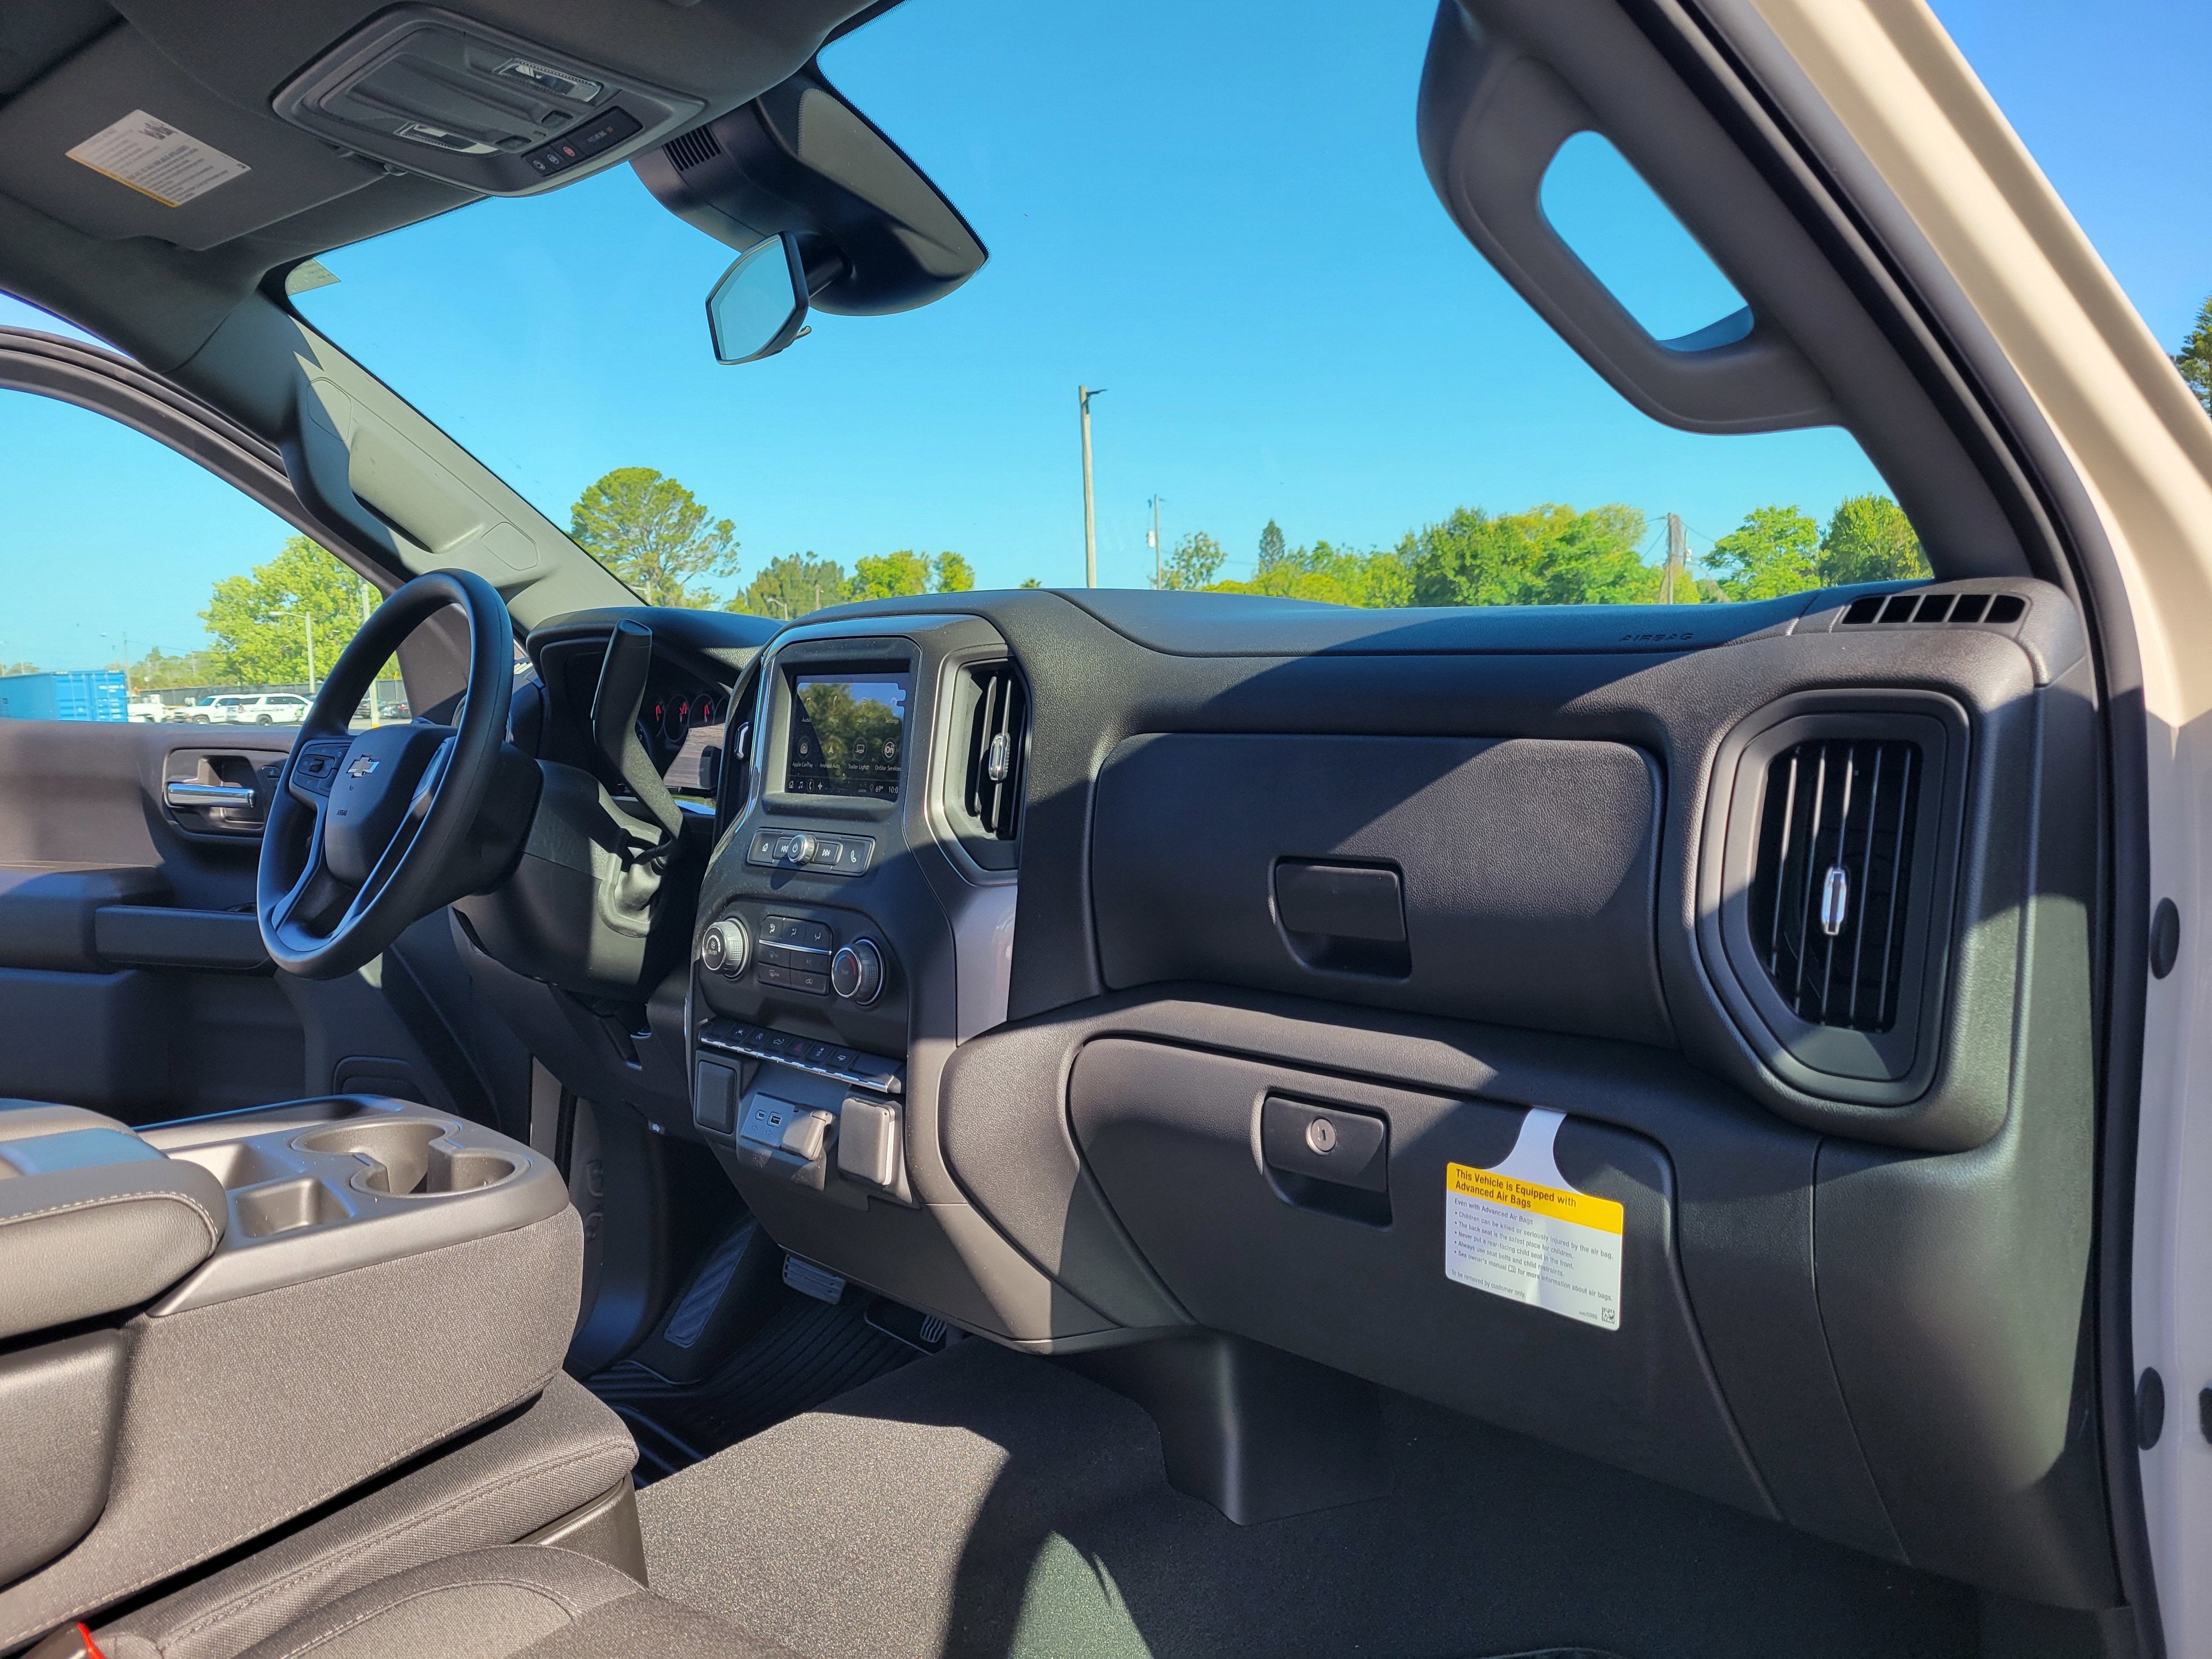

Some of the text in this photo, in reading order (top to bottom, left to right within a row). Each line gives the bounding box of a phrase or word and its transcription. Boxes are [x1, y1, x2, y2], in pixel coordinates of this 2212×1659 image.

[1620, 633, 1693, 641] AIRBAG
[1455, 1180, 1531, 1208] Advanced Air Bags
[1456, 1169, 1576, 1207] This Vehicle is Equipped with
[1455, 1198, 1467, 1207] Even
[1481, 1205, 1508, 1218] Advanced
[1519, 1215, 1533, 1225] Bags
[1459, 1211, 1480, 1222] Children
[1500, 1223, 1515, 1232] killed
[1523, 1229, 1549, 1242] seriously
[1550, 1236, 1570, 1247] injured
[1571, 1242, 1578, 1250] by
[1580, 1244, 1589, 1252] the
[1600, 1250, 1613, 1260] bag.
[1459, 1231, 1472, 1239] Never
[1487, 1241, 1515, 1254] rear-facing
[1516, 1248, 1530, 1256] child
[1531, 1252, 1543, 1260] seat
[1560, 1260, 1574, 1269] front.
[1469, 1224, 1480, 1233] back
[1509, 1235, 1525, 1245] safest
[1526, 1240, 1541, 1249] place
[1550, 1247, 1574, 1259] children.
[1458, 1240, 1475, 1251] Always
[1498, 1252, 1511, 1261] belts
[1523, 1260, 1537, 1268] child
[1538, 1264, 1564, 1277] restraints.
[1458, 1250, 1467, 1259] See
[1468, 1255, 1487, 1264] owner's
[1488, 1260, 1506, 1270] manual
[1526, 1271, 1540, 1279] more
[1541, 1276, 1570, 1289] information
[1572, 1285, 1587, 1294] about
[1598, 1290, 1613, 1301] bags.
[1464, 1274, 1483, 1285] removed
[1485, 1279, 1490, 1288] by
[1491, 1283, 1514, 1294] customer
[1514, 1290, 1526, 1298] only.
